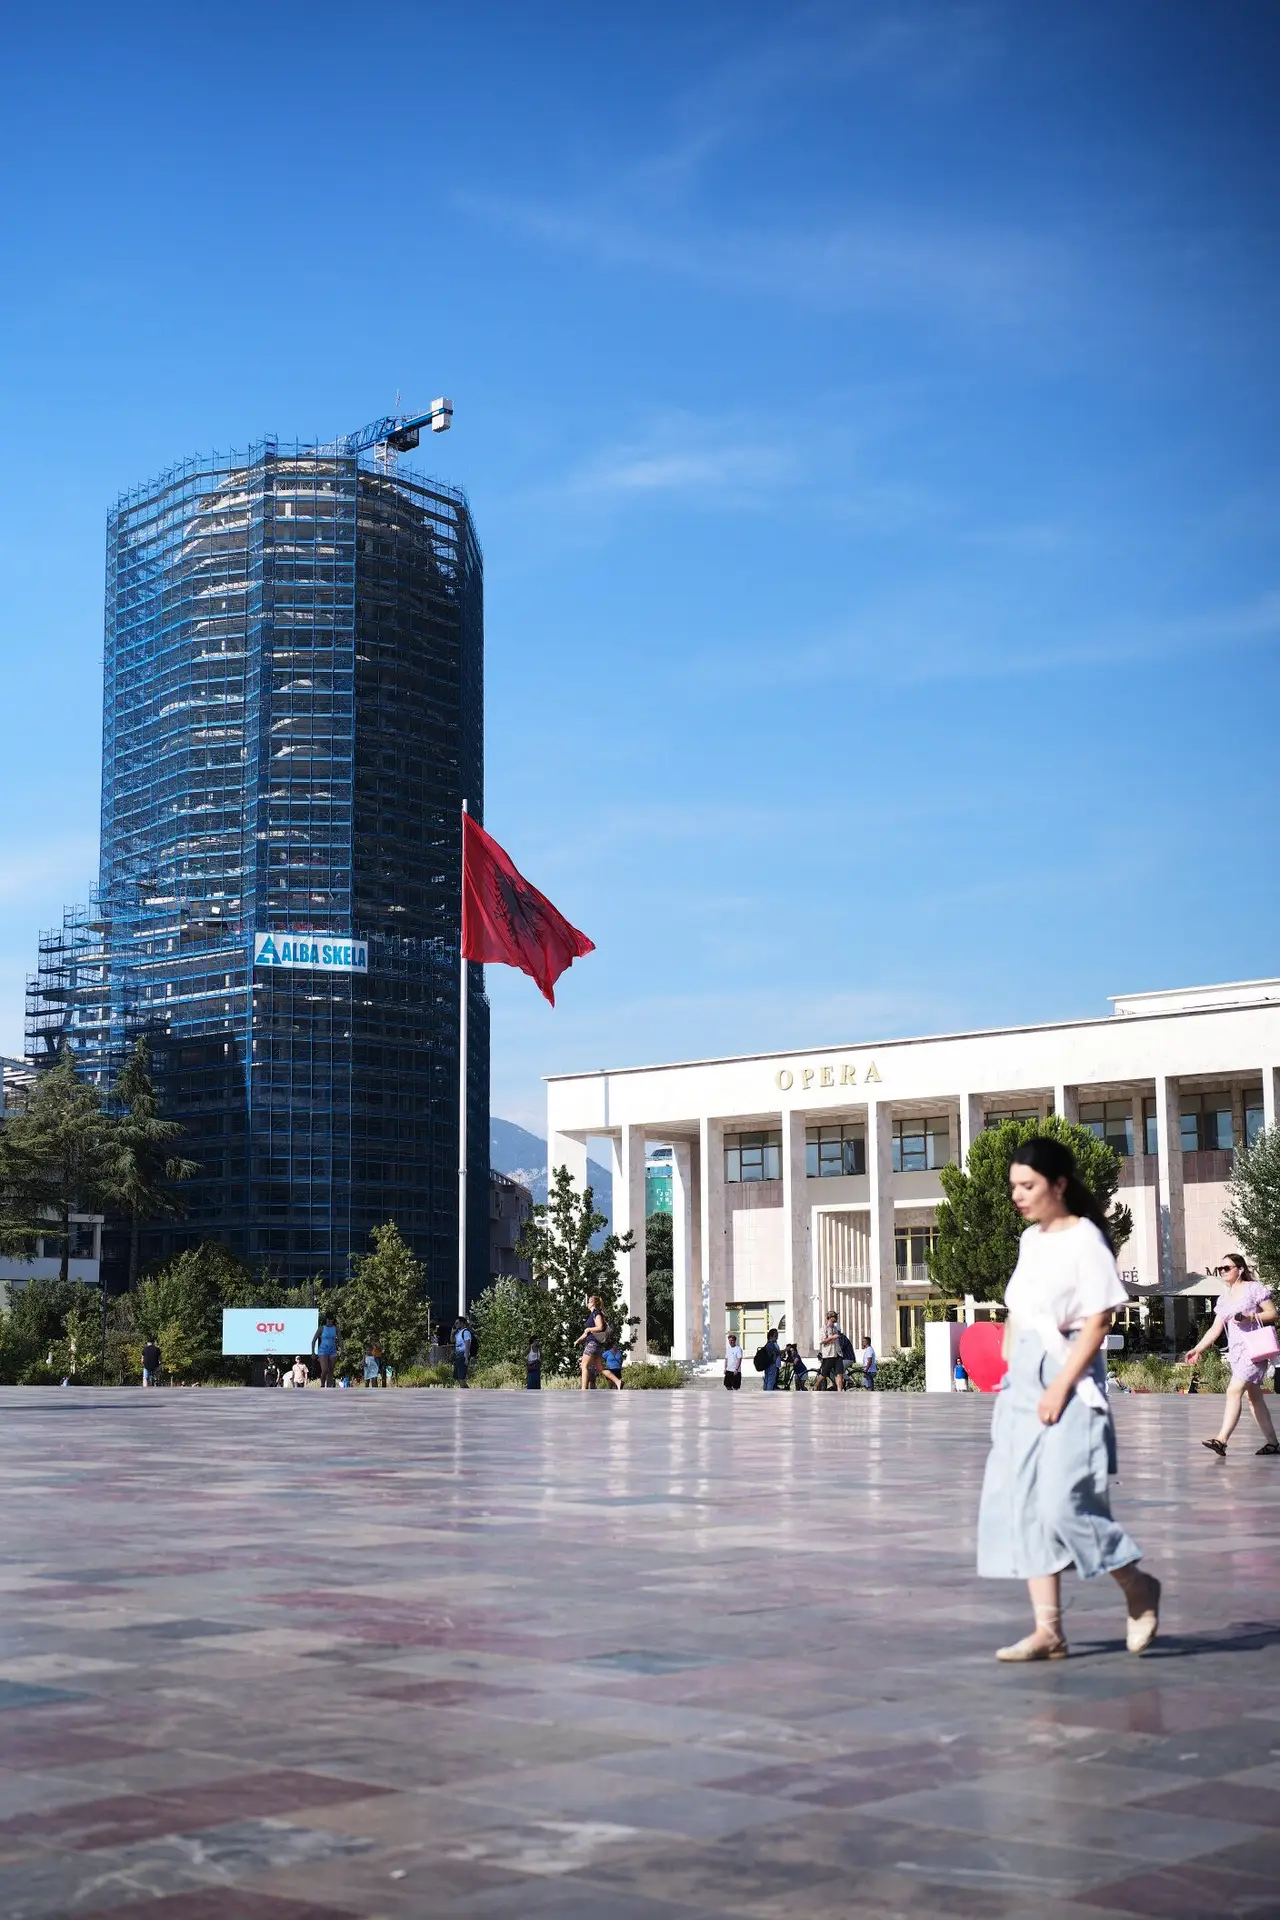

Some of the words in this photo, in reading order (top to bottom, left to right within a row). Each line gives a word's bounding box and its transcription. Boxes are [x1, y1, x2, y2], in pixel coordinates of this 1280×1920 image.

[282, 942, 319, 963] ALBA
[322, 944, 365, 967] SKELA
[775, 1060, 882, 1091] OPERA
[1119, 1267, 1138, 1282] FÉ
[256, 1322, 284, 1333] QTU
